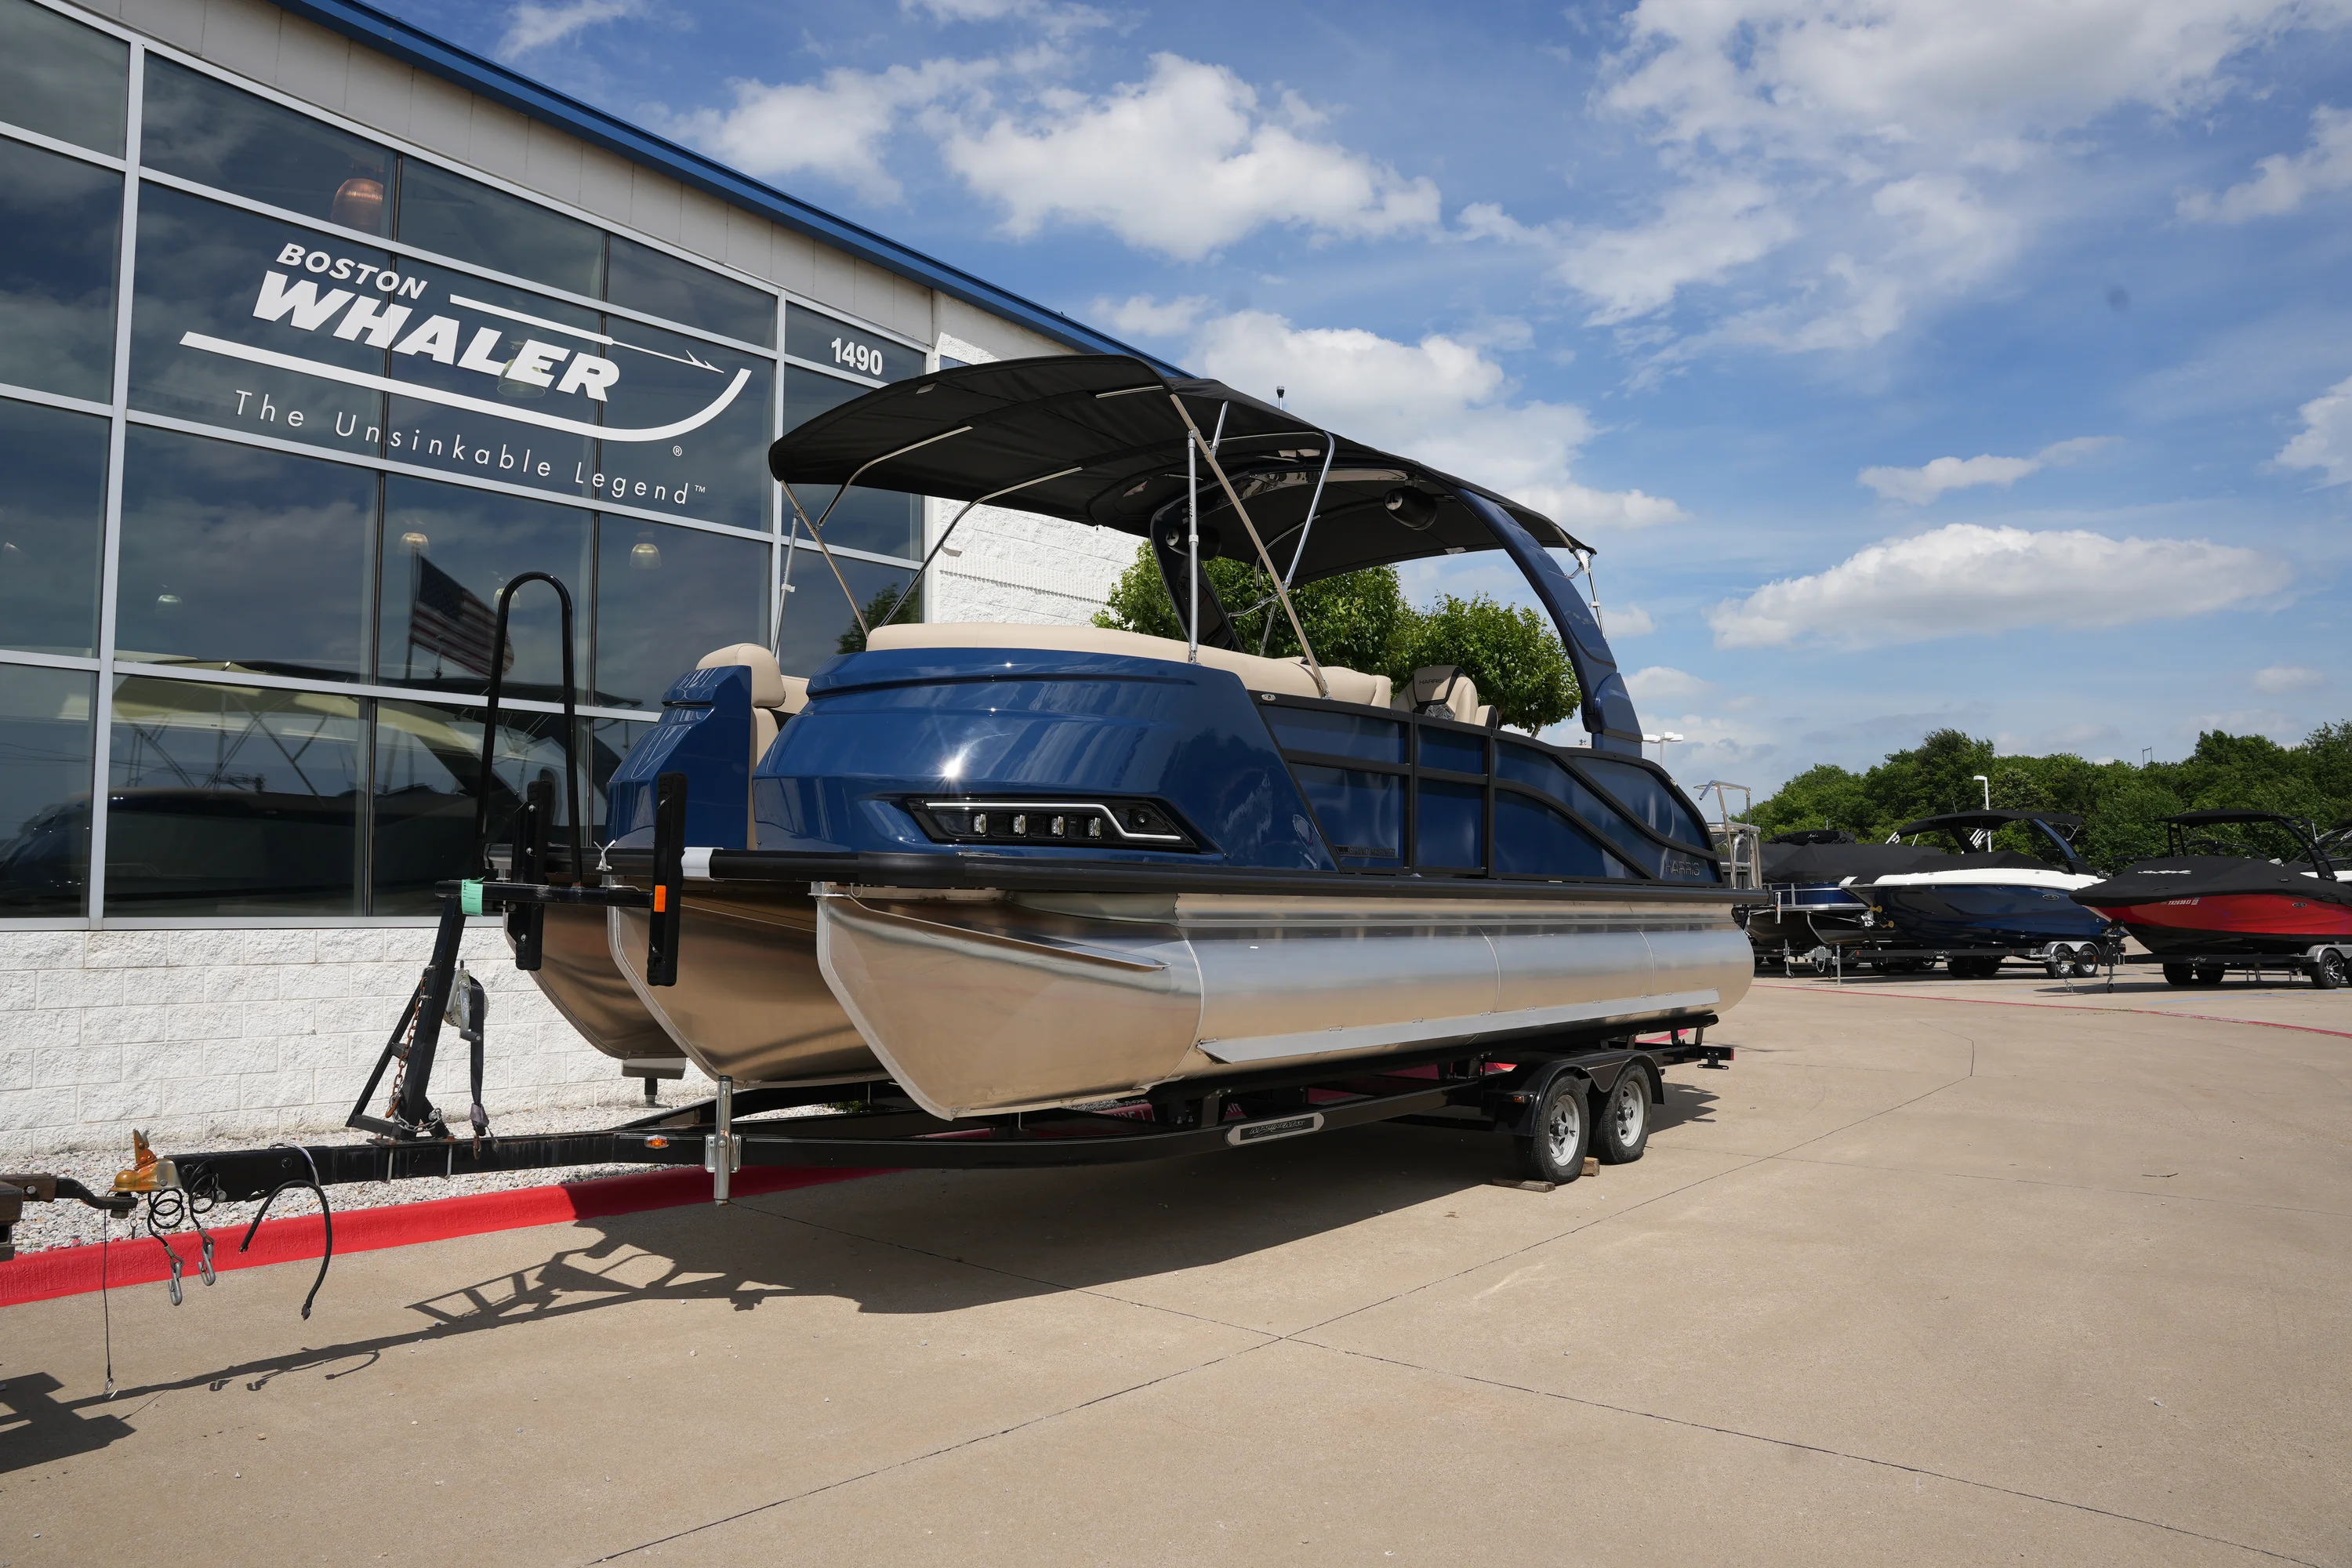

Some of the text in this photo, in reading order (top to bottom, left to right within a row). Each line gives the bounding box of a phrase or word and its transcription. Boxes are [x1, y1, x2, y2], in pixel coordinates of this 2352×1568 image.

[277, 242, 428, 299] BOSTON
[252, 270, 620, 402] WHALER
[831, 337, 883, 376] 1490
[234, 390, 304, 428] The
[336, 412, 551, 477] Unsinkable
[1664, 859, 1700, 876] HARRIS
